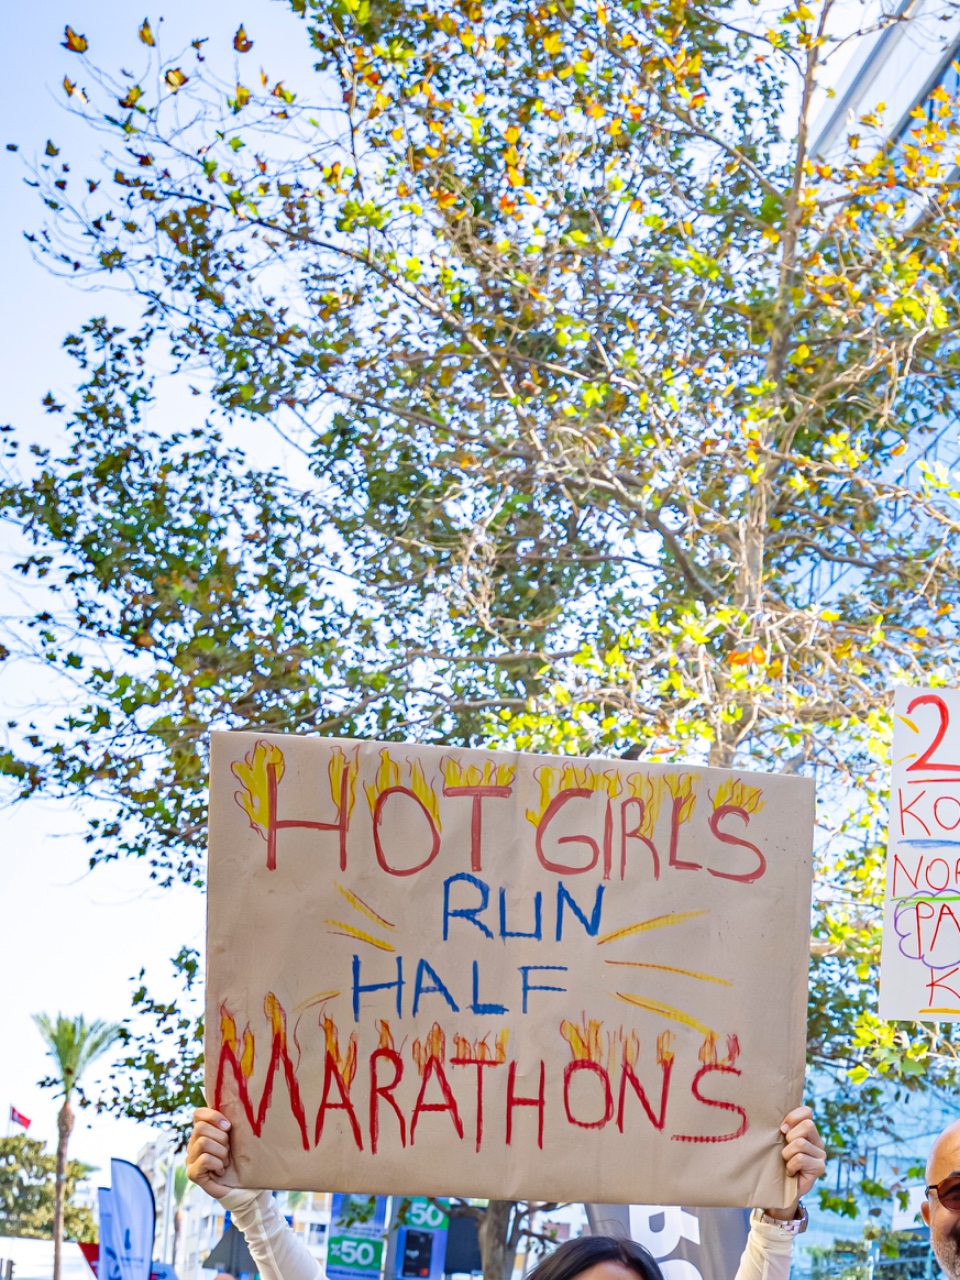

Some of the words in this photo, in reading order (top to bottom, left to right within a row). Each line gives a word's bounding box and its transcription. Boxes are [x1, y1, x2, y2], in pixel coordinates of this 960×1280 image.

[265, 764, 513, 877] HOT
[535, 786, 768, 884] GIRLS
[443, 872, 606, 942] RUN
[350, 954, 569, 1022] HALF
[213, 1032, 750, 1155] MARATHONS
